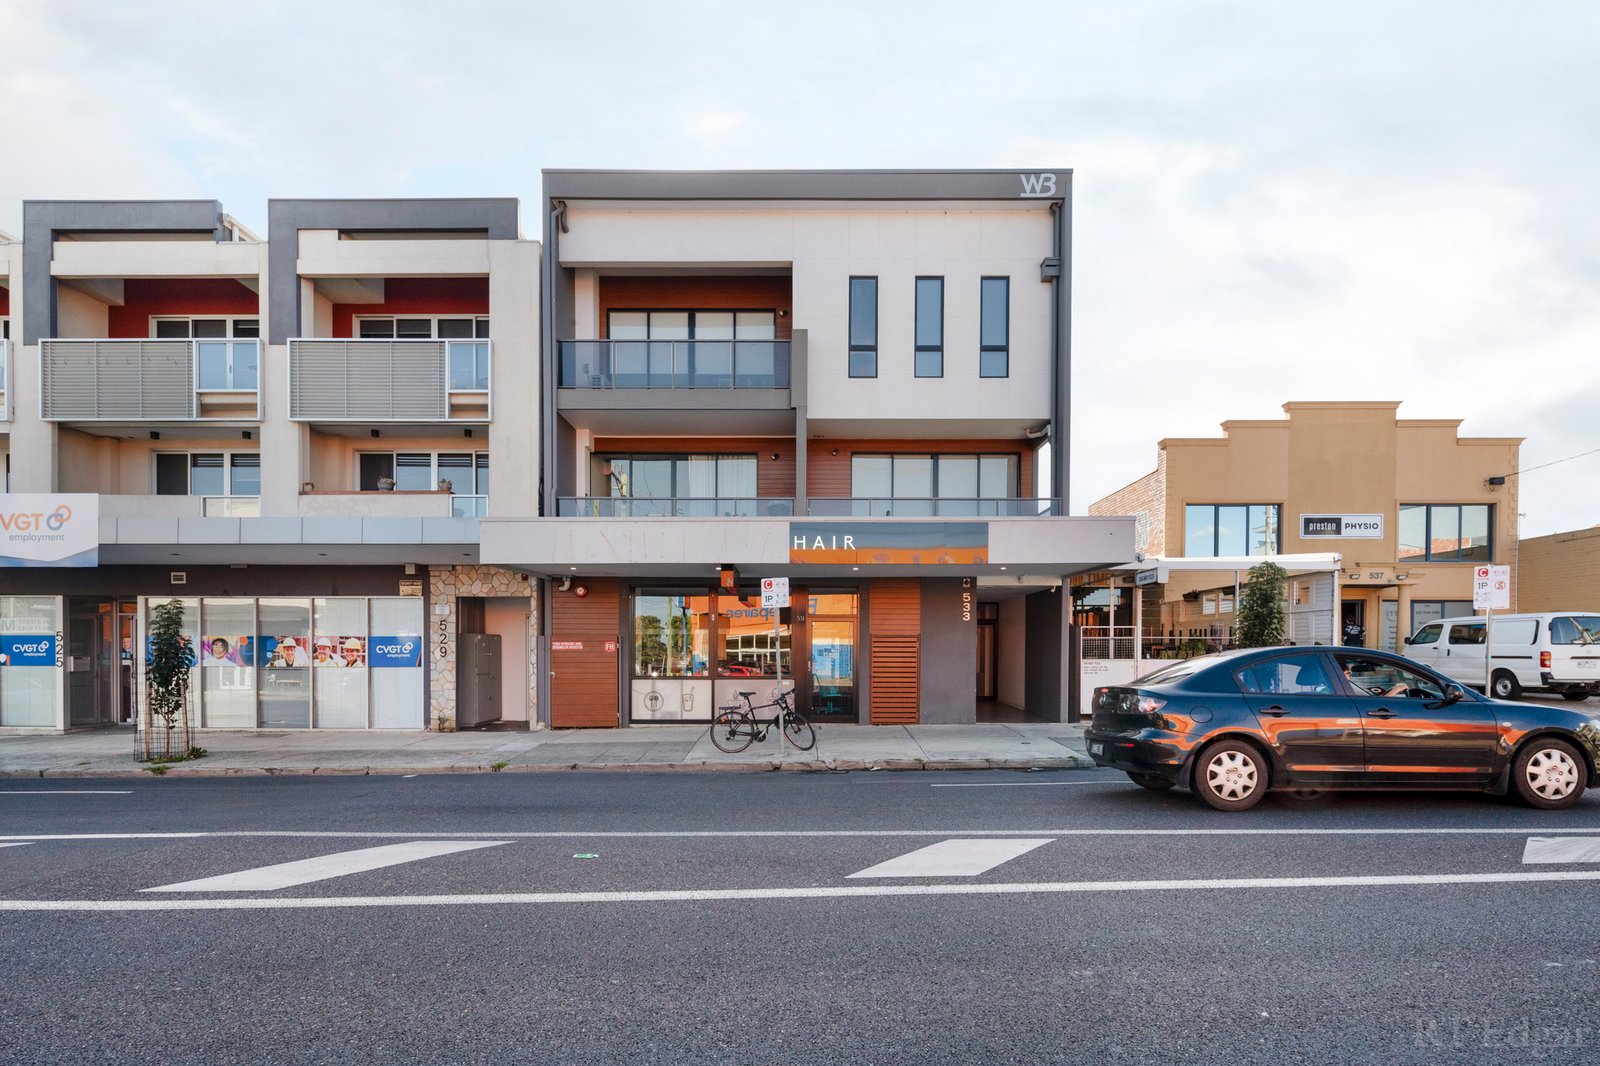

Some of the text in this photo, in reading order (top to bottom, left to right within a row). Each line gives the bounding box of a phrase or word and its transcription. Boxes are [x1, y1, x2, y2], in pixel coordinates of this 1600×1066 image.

[1309, 522, 1379, 531] preston PHYSIO
[9, 534, 65, 542] employment
[794, 536, 856, 550] HAIR
[1369, 572, 1384, 580] 537
[765, 595, 774, 603] 1P
[963, 593, 971, 621] 533
[12, 643, 38, 653] CVGT
[376, 645, 401, 654] CVGT
